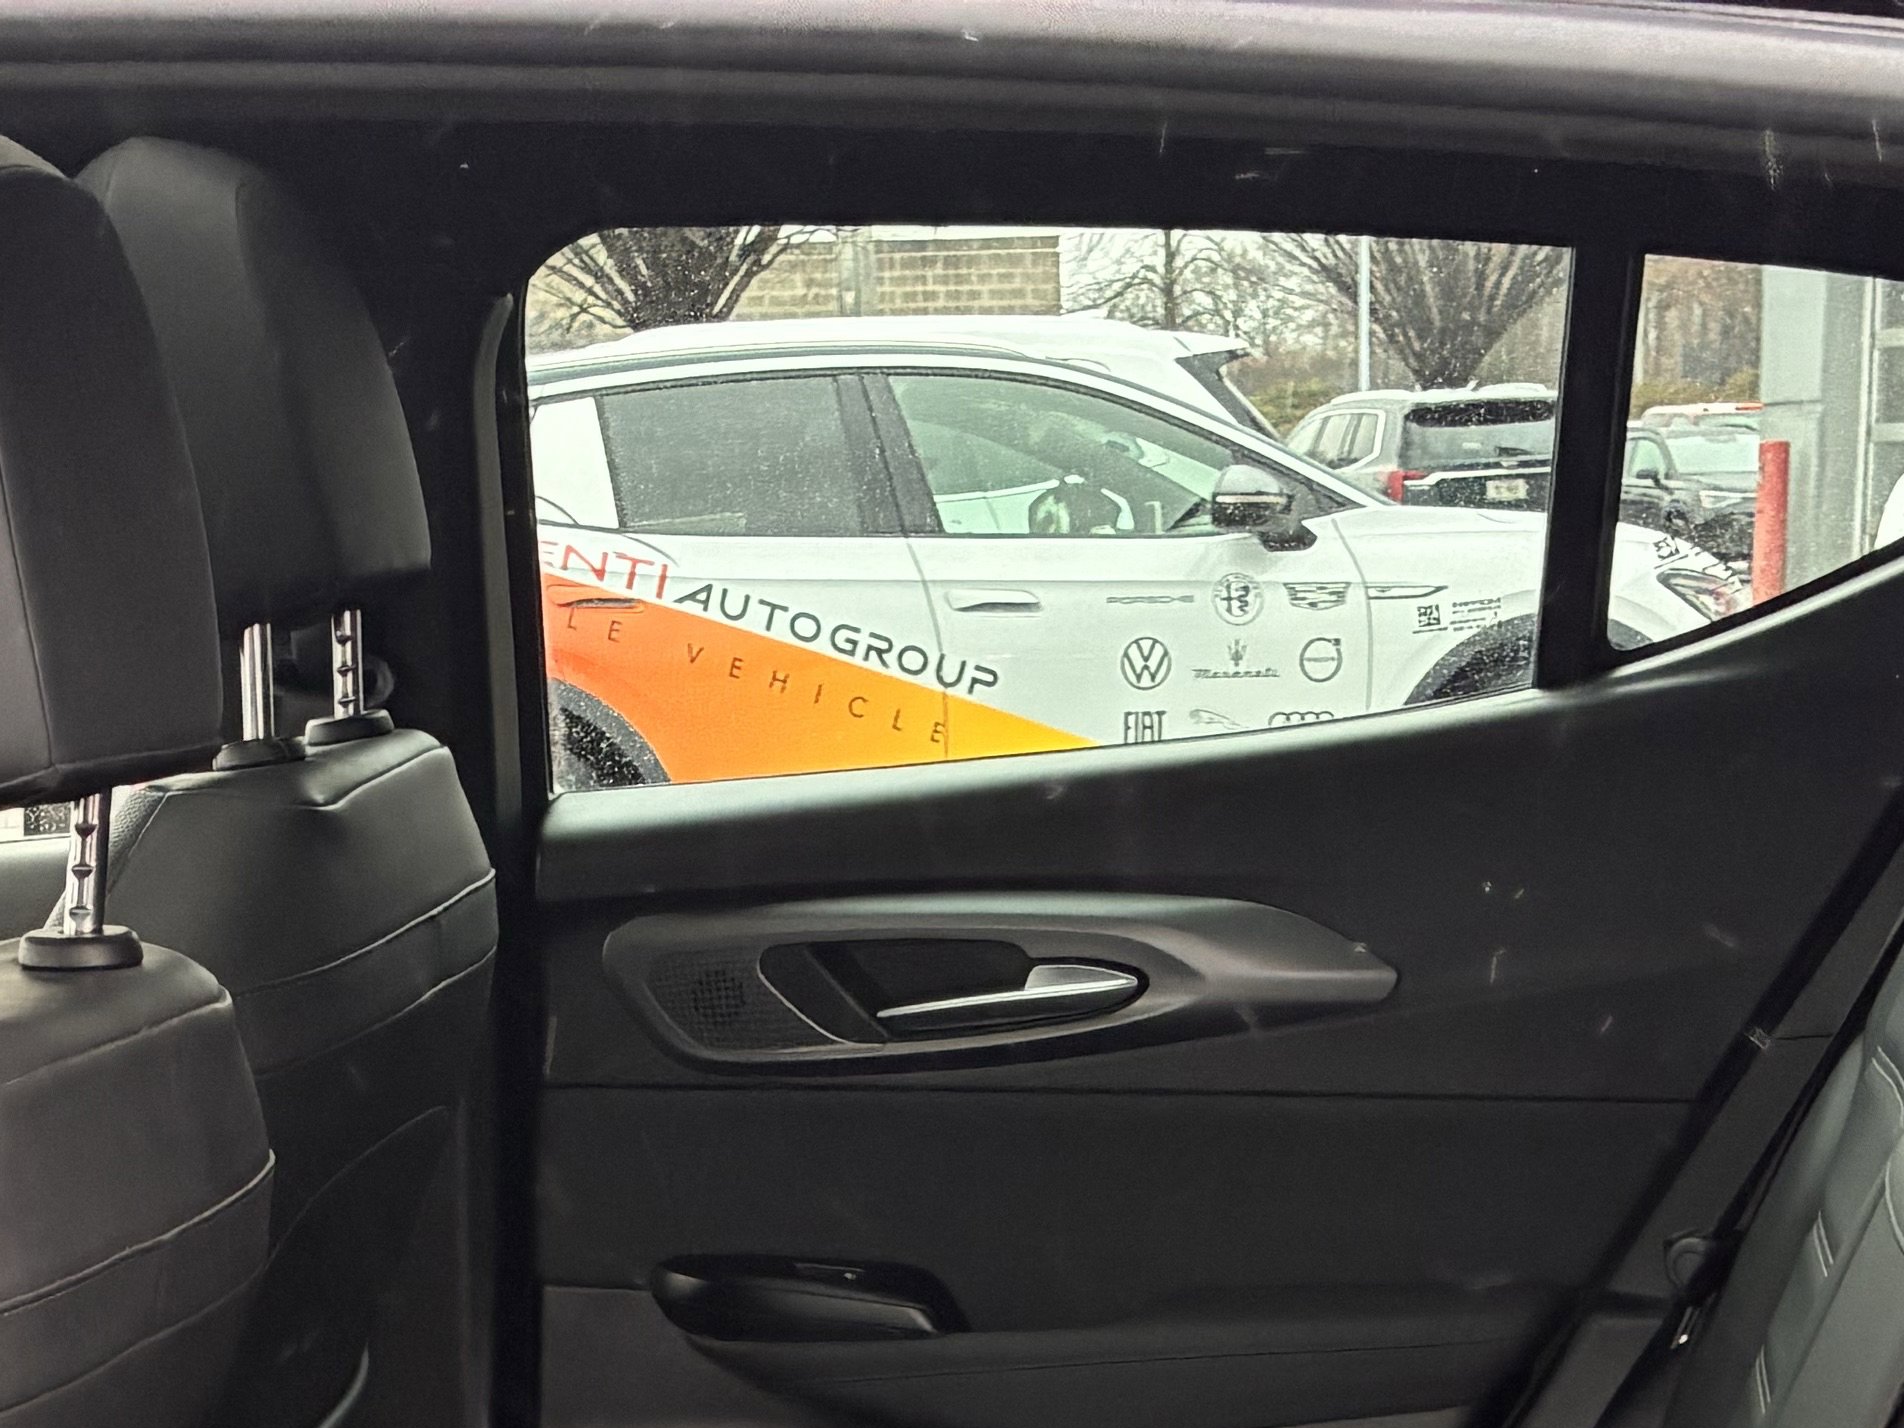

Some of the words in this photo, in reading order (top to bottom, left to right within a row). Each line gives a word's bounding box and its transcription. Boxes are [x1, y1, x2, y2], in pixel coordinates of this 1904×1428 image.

[672, 582, 1000, 696] AUTOGROUP
[686, 642, 948, 745] VEHICLE
[1123, 711, 1167, 743] FIAT
